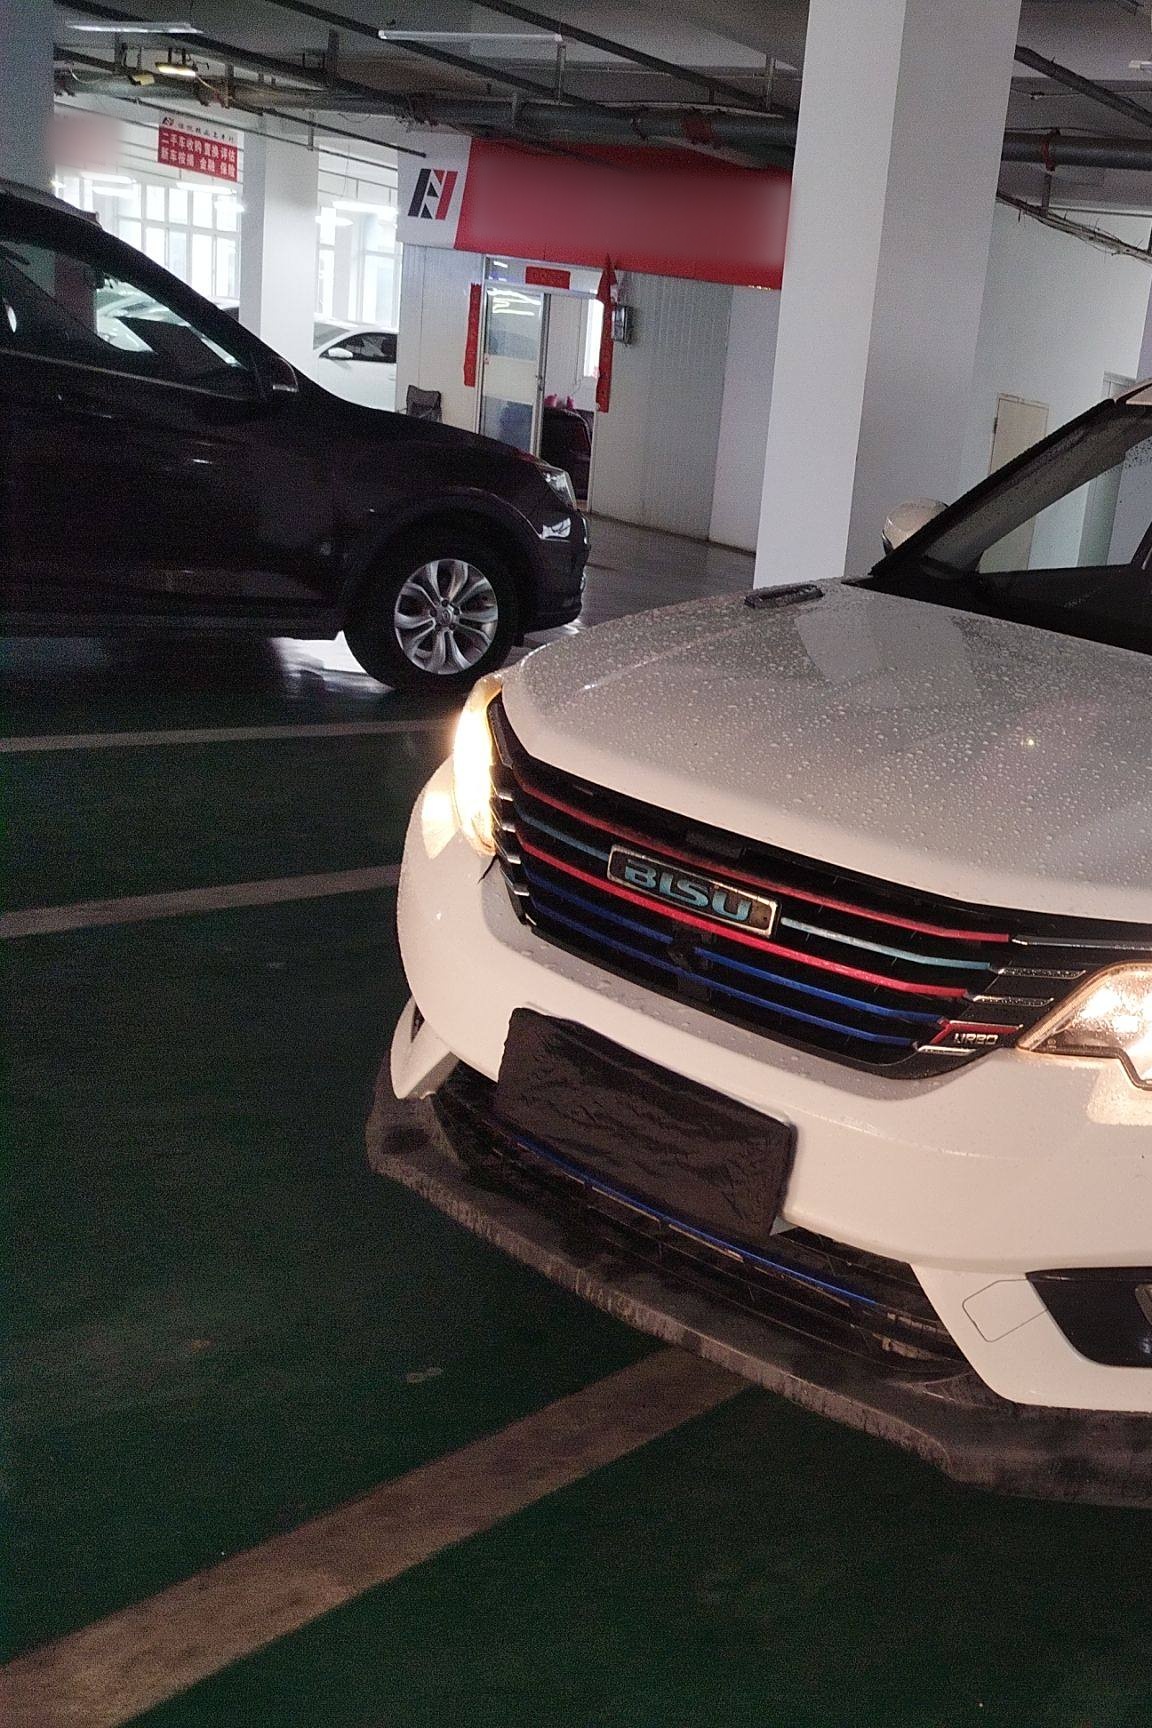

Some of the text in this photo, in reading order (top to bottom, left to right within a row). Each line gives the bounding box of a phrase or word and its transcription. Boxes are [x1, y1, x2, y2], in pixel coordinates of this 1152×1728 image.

[162, 132, 202, 154] 二手车收购
[624, 859, 752, 921] BISU
